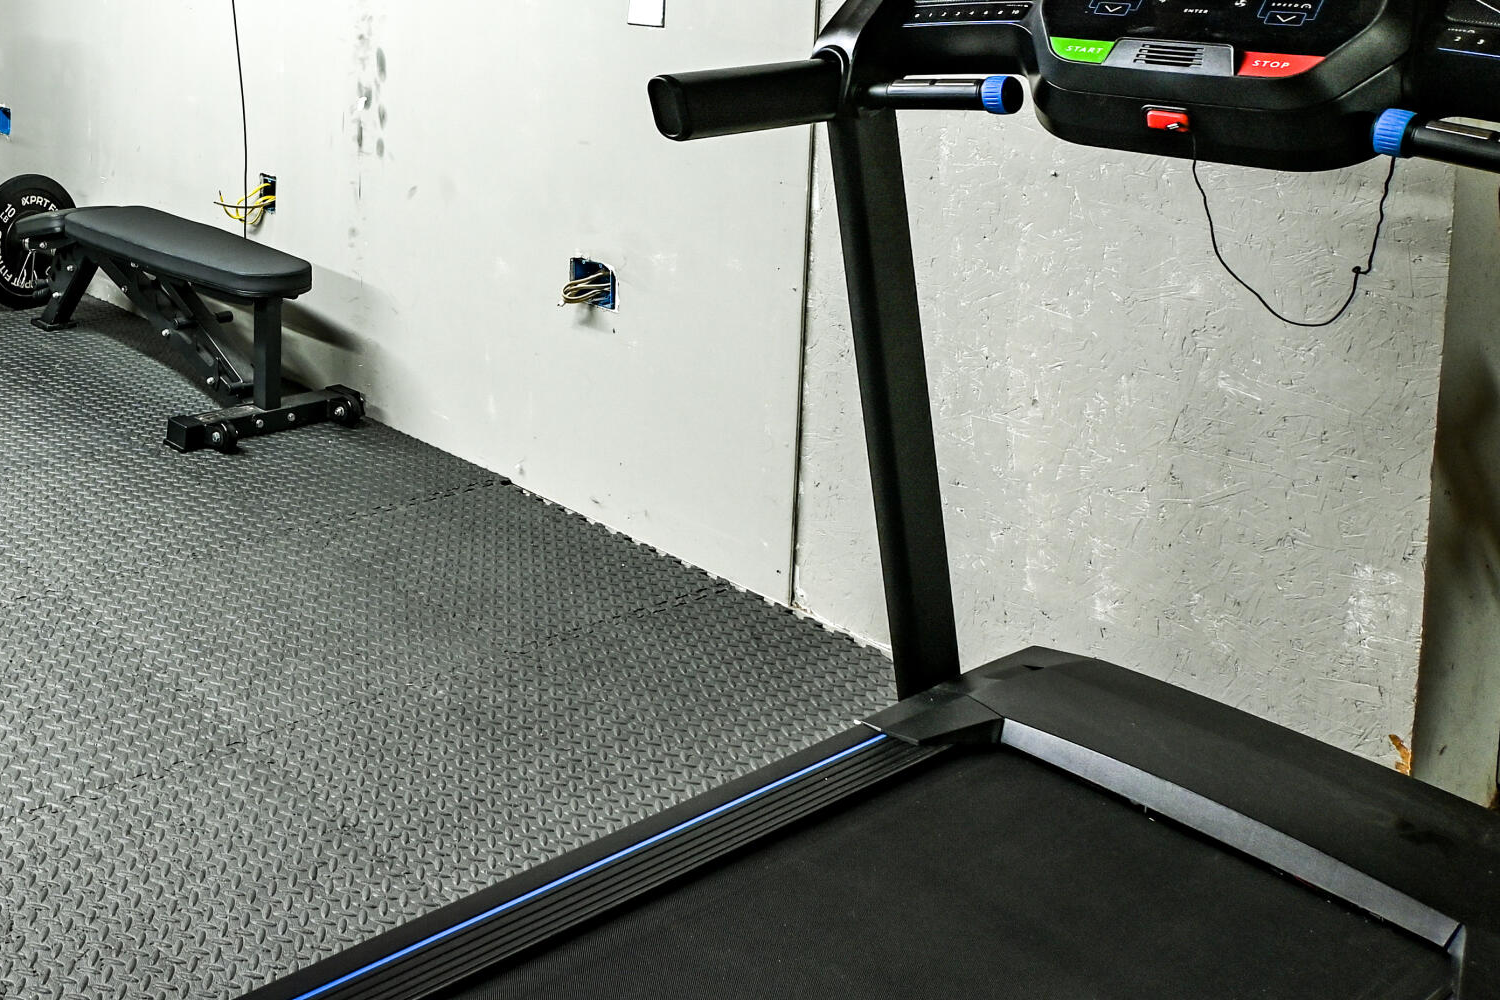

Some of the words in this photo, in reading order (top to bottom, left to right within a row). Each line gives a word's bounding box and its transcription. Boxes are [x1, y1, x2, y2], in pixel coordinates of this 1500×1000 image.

[1065, 44, 1104, 54] START
[1252, 59, 1290, 69] STOP
[4, 203, 16, 218] 10
[0, 212, 9, 223] LB
